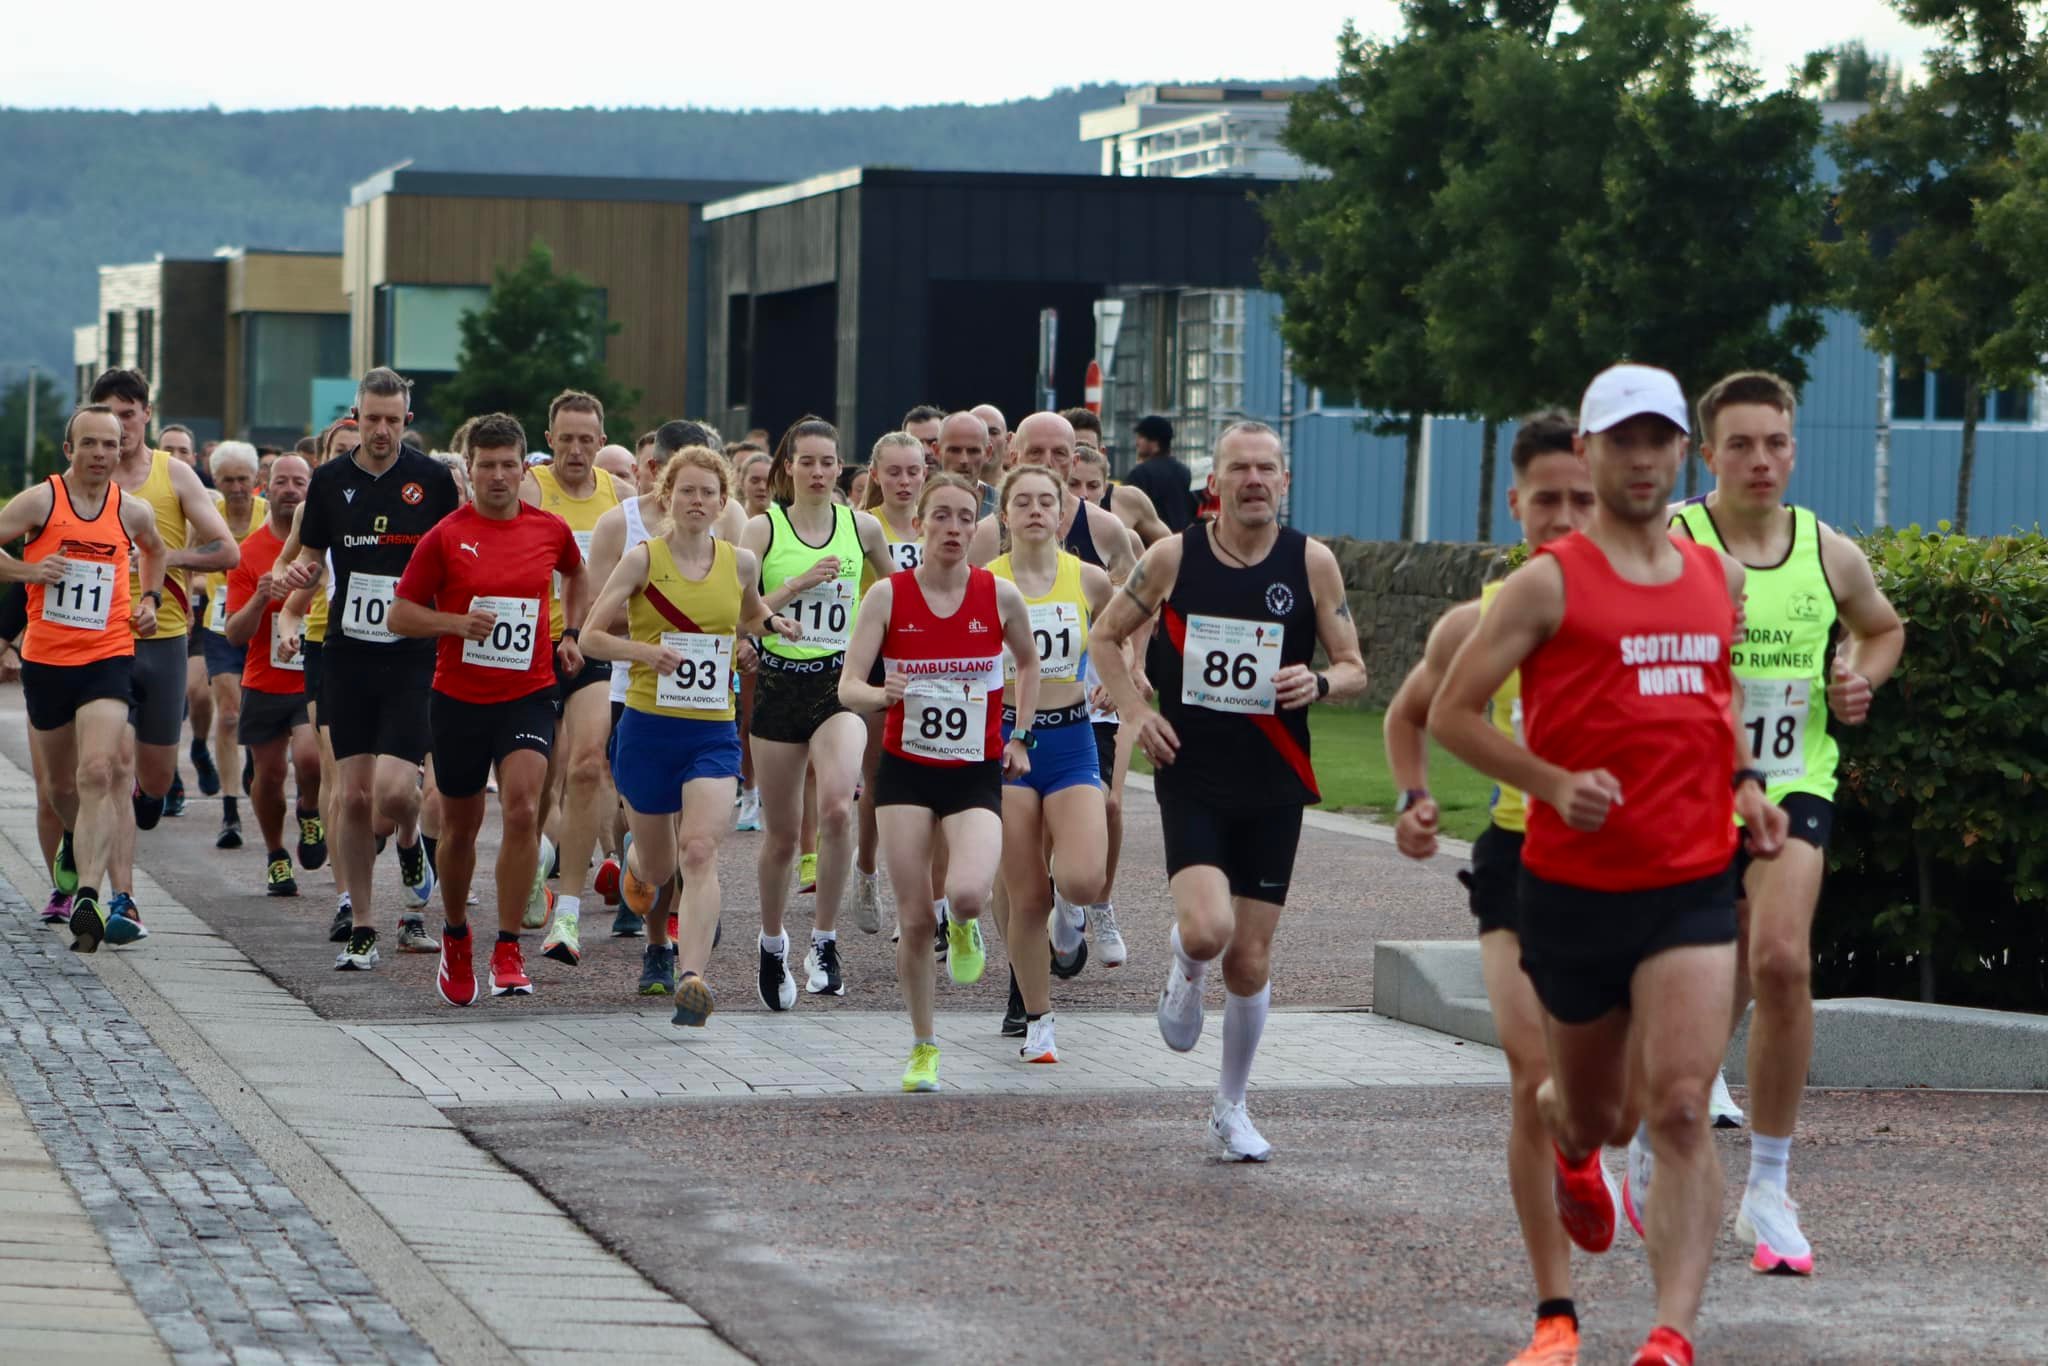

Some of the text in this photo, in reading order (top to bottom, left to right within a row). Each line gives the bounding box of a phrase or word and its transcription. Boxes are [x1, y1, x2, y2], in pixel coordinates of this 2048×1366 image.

[53, 580, 102, 612] 111
[352, 596, 392, 625] 10
[789, 599, 846, 632] 110
[478, 622, 531, 652] 03
[1033, 628, 1070, 661] 01
[1620, 634, 1719, 666] SCOTLAND
[466, 652, 495, 662] KYNISKA
[782, 660, 824, 673] PRO
[898, 661, 993, 674] AMBUSLANG
[1203, 650, 1258, 690] 86
[1750, 652, 1814, 669] RUNNERS
[676, 658, 717, 690] 93
[1638, 667, 1704, 696] NORTH
[660, 693, 726, 705] KYNISKA ADVOCACY
[920, 706, 968, 741] 89
[1032, 712, 1063, 726] RO
[906, 740, 981, 756] KYNISKA ADVOCACY
